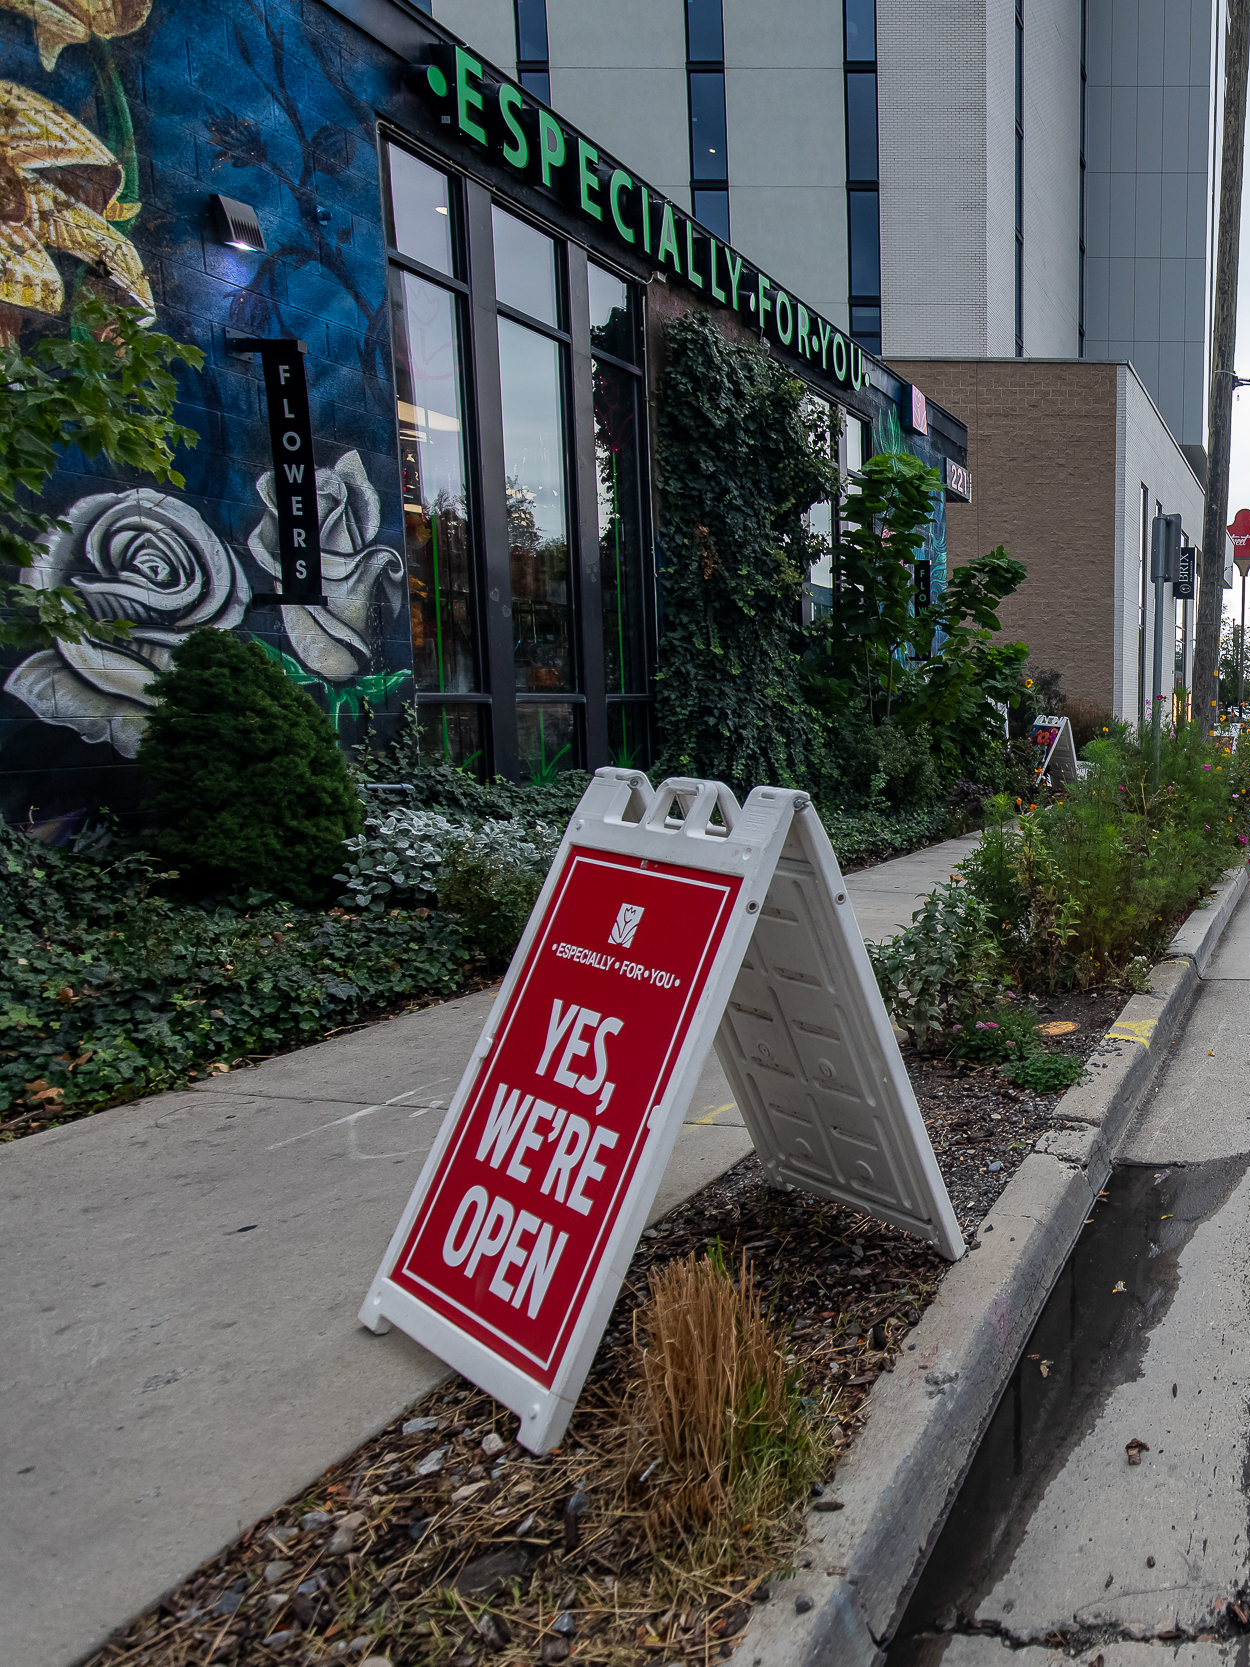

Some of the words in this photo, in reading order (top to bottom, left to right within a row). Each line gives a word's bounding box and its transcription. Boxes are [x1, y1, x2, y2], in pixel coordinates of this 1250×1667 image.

[455, 44, 744, 312] ESPECIALLY
[758, 272, 811, 361] FOR
[815, 318, 864, 392] YOU
[278, 364, 308, 580] FLOWERS
[950, 463, 967, 496] 221
[1178, 553, 1189, 582] BRIX
[556, 942, 614, 972] ESPECIALLY
[619, 959, 644, 981] FOR
[650, 968, 676, 989] YOU
[535, 998, 625, 1116] YES,
[475, 1082, 619, 1217] WE'RE
[442, 1185, 569, 1321] OPEN
